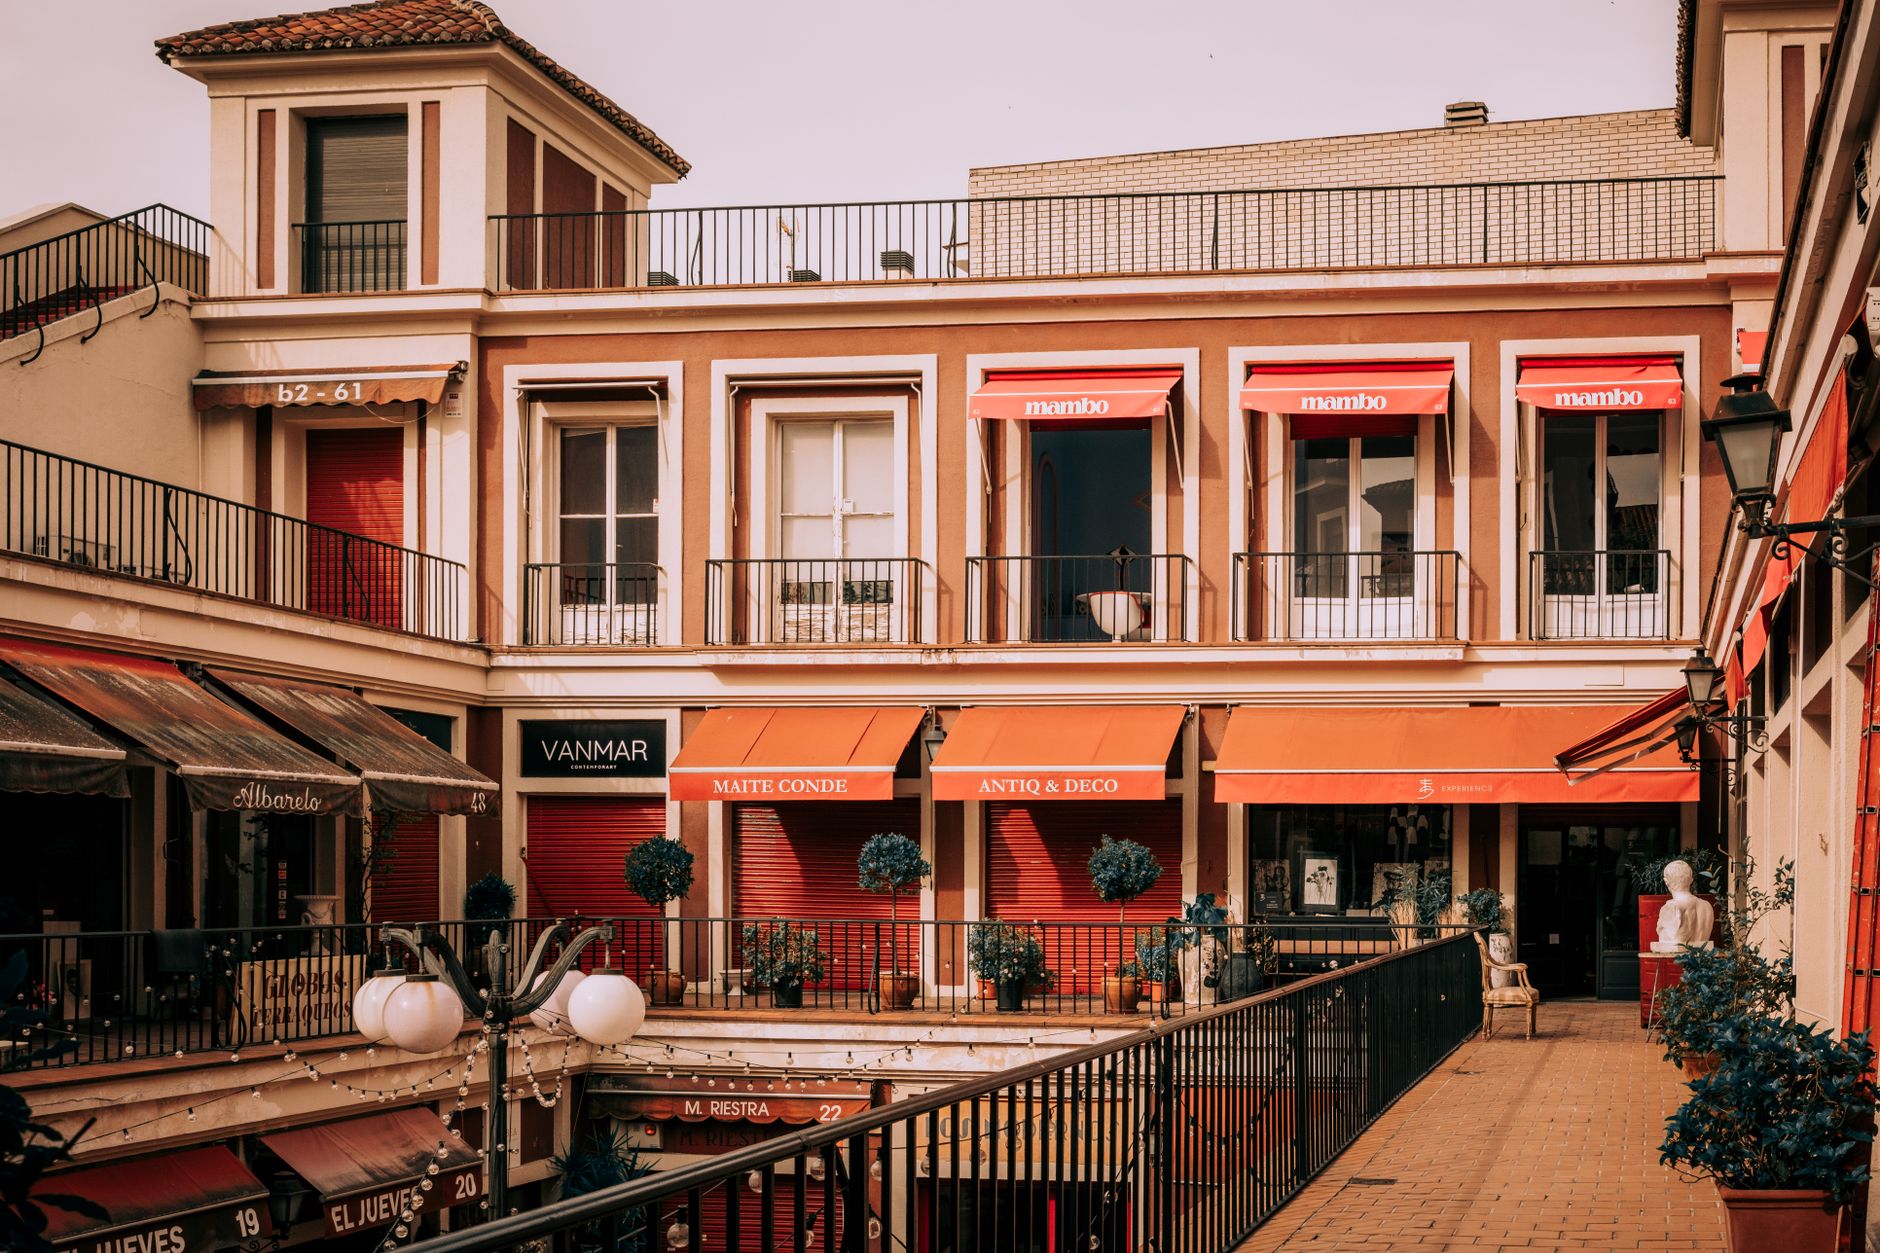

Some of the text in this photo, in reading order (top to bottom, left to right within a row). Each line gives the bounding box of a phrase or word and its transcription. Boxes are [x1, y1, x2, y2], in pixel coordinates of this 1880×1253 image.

[278, 383, 309, 402] b2
[334, 382, 361, 401] 61
[1300, 392, 1387, 410] mambo
[1554, 388, 1644, 406] mambo
[1024, 397, 1109, 415] mambo
[541, 740, 648, 761] VANMAR
[712, 779, 848, 793] MAITE CONDE
[978, 778, 1118, 795] ANTIQ & DECO
[232, 781, 322, 812] Albarelo
[470, 792, 486, 813] 48
[685, 1101, 770, 1116] M. RIESTRA
[819, 1104, 842, 1121] 22
[455, 1173, 477, 1199] 20
[235, 1208, 260, 1238] 19
[331, 1204, 355, 1233] EL
